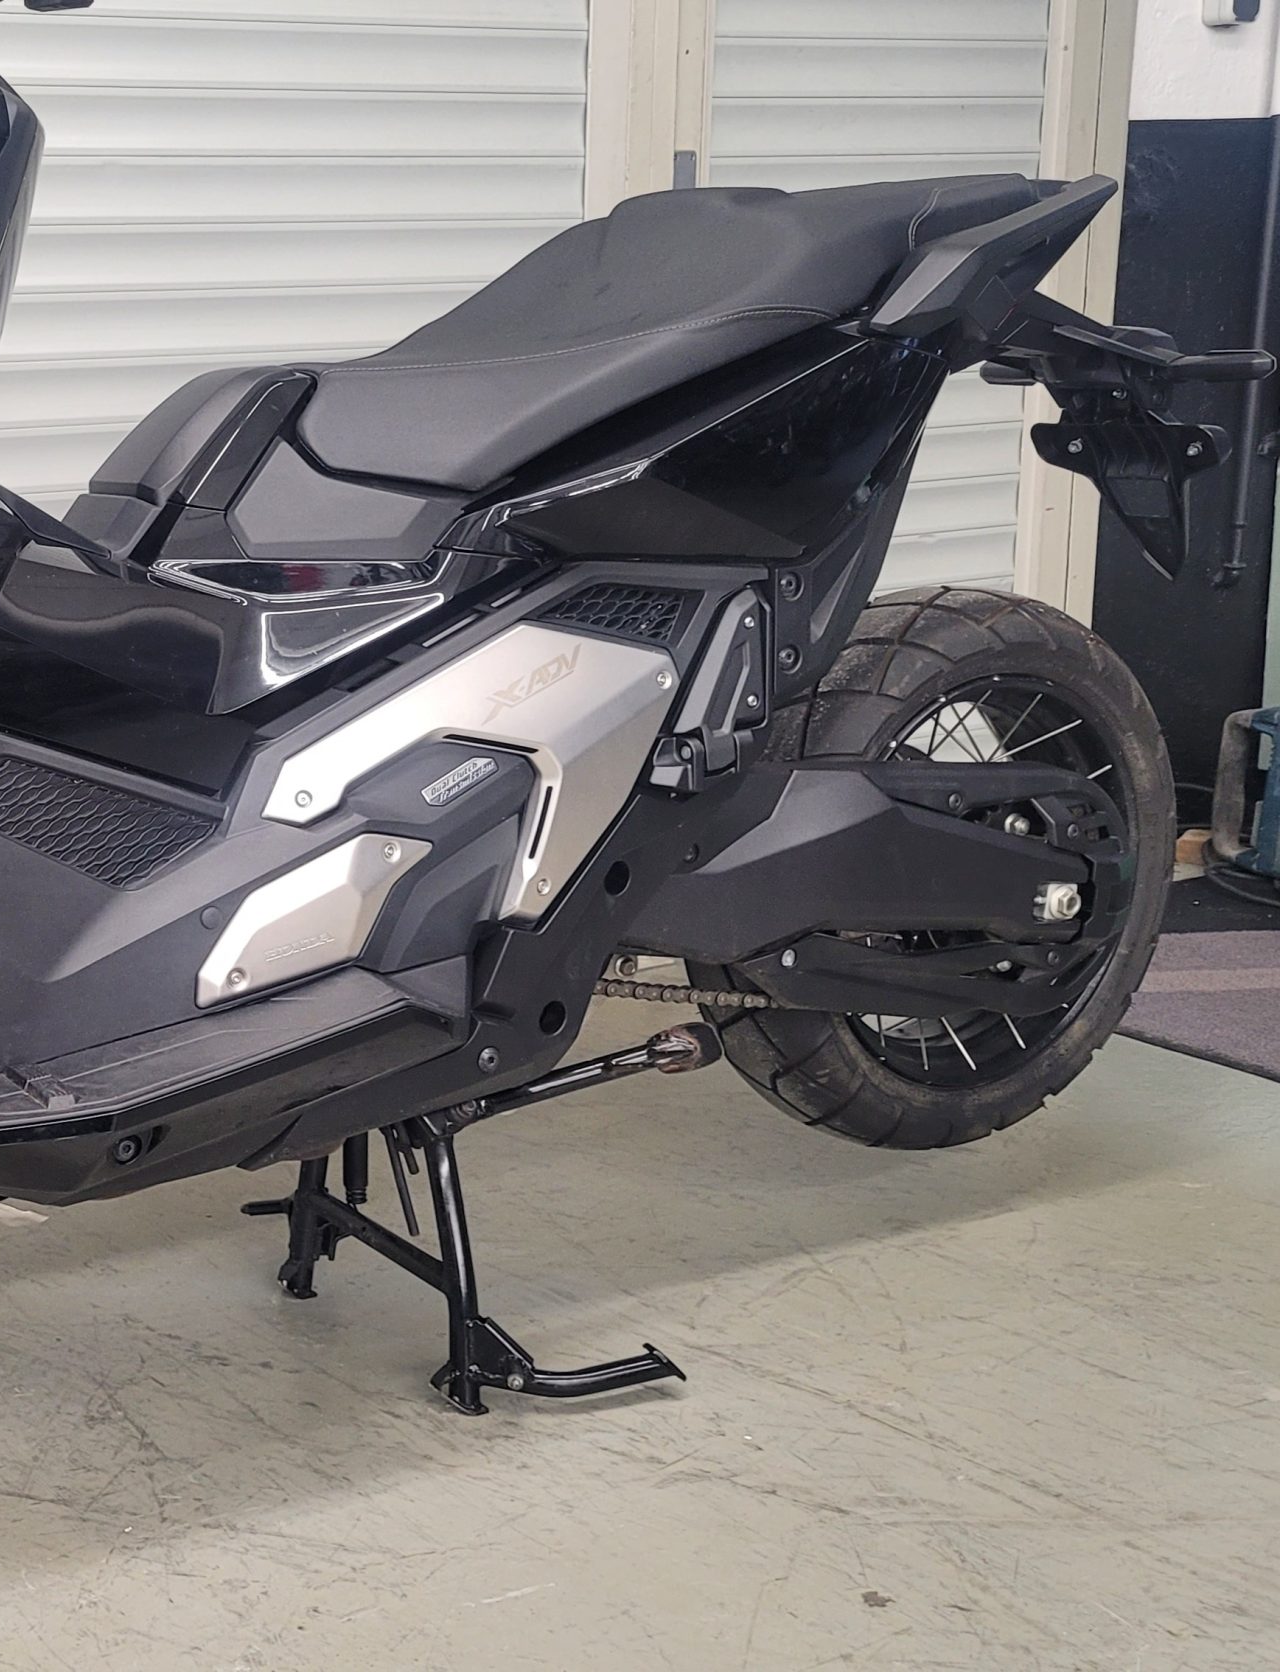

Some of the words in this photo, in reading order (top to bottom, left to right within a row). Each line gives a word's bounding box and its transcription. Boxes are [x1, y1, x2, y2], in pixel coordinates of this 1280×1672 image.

[481, 643, 582, 726] X-ADV
[430, 778, 451, 796] Dual
[452, 762, 478, 783] Clutch
